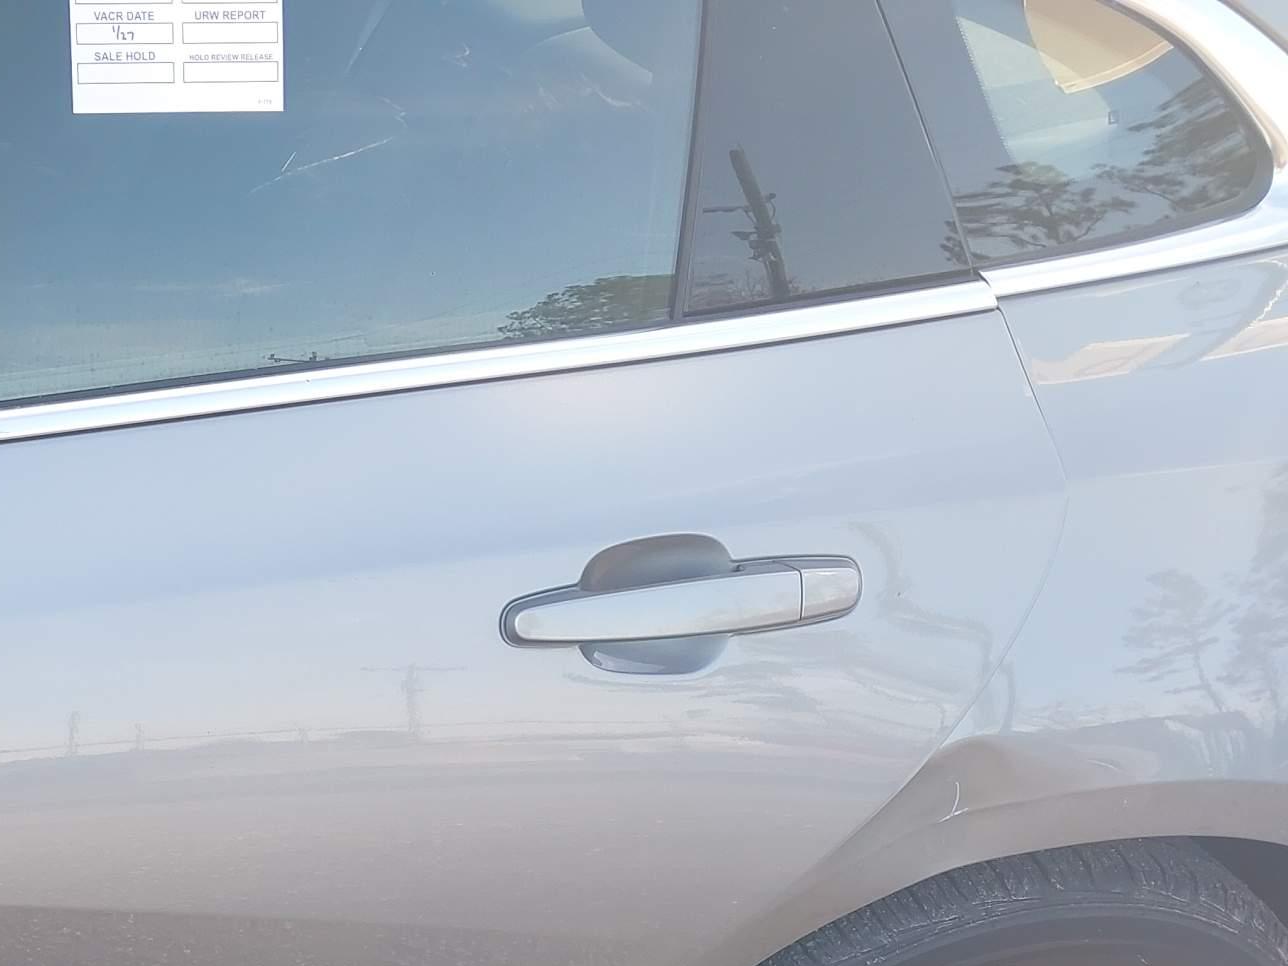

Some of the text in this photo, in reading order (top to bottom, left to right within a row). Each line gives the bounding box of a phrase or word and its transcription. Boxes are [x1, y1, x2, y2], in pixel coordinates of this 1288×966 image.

[93, 11, 155, 21] VACR DATE
[194, 10, 266, 20] URW REPORT
[112, 25, 135, 41] 1/27
[94, 51, 156, 62] SALE HOLD
